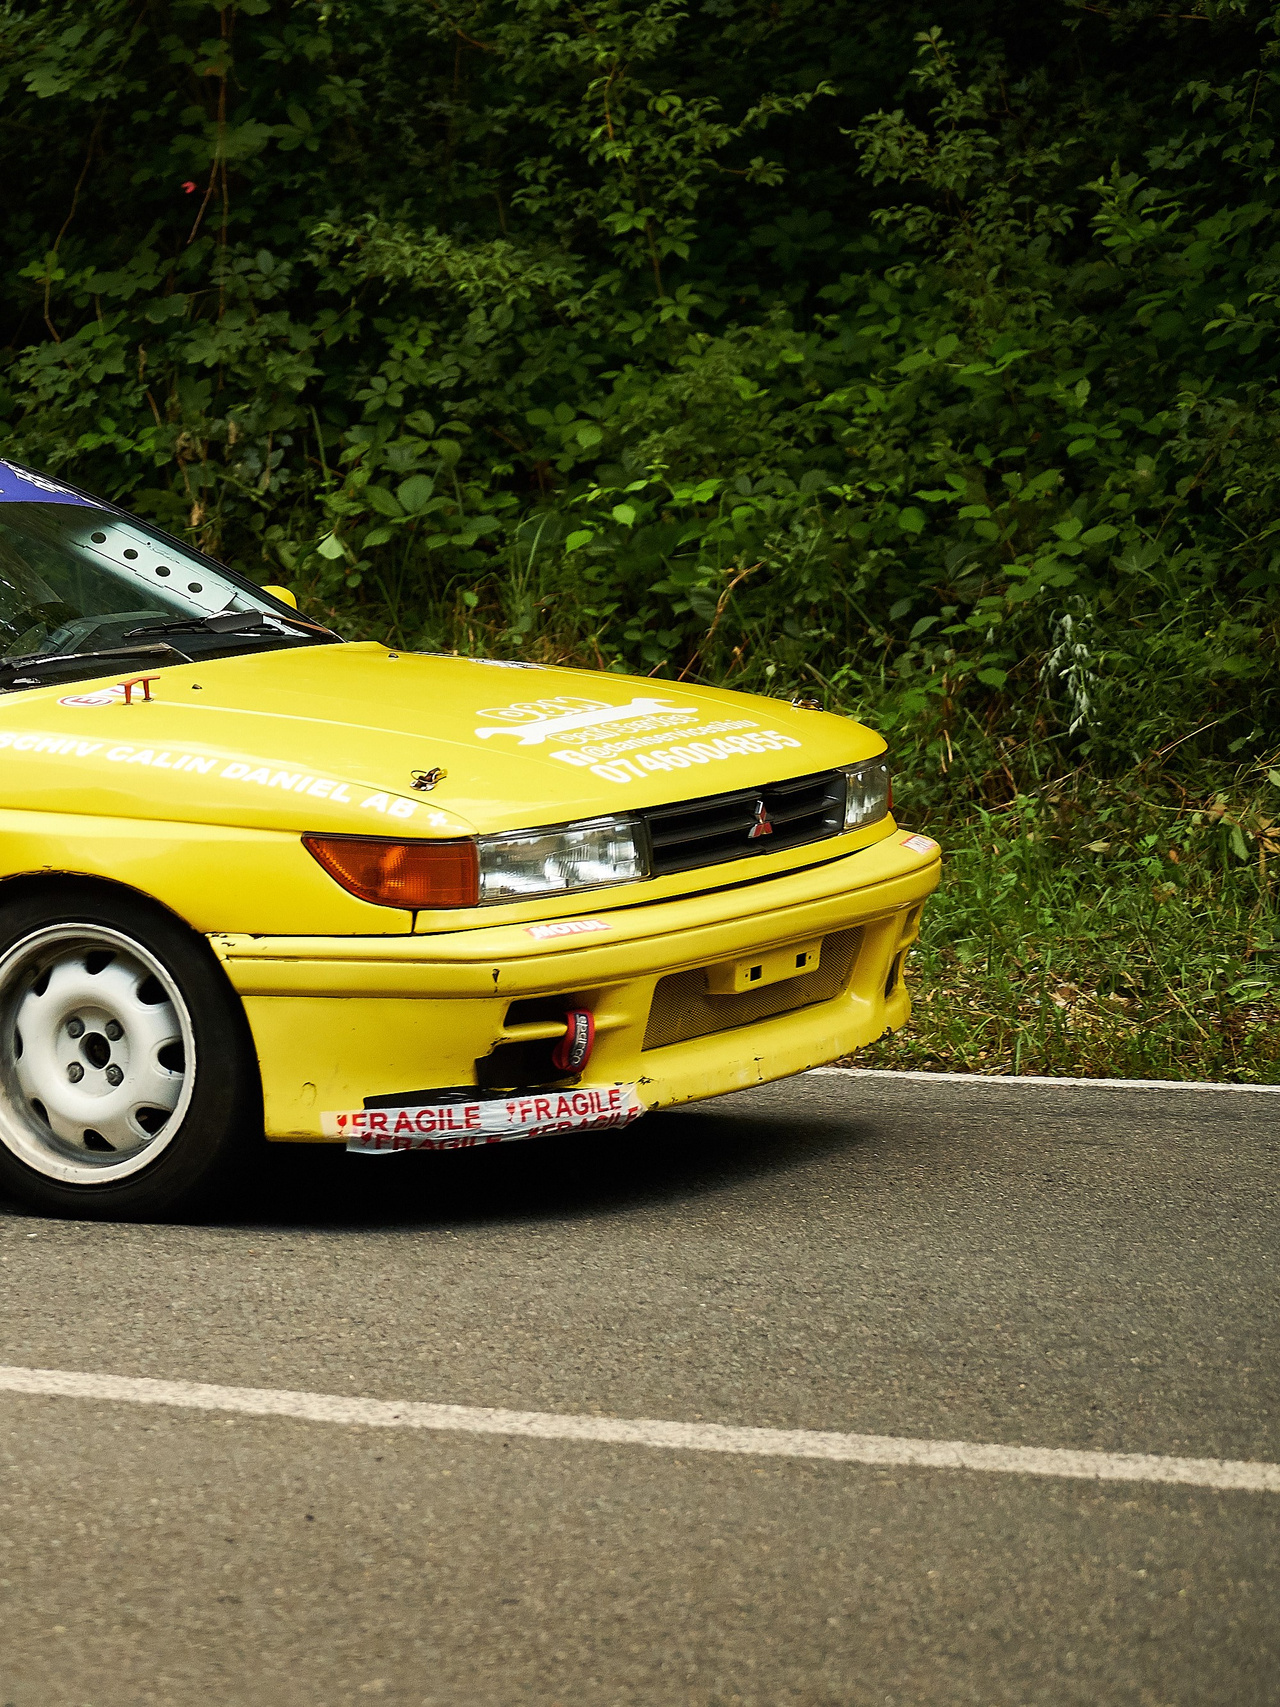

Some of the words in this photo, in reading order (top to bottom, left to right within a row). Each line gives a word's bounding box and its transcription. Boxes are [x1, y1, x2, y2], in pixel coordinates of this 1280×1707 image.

[106, 744, 223, 775] CALIN
[219, 761, 352, 803] DANIEL
[362, 793, 419, 819] AB
[590, 730, 802, 784] 0746004855
[529, 919, 609, 939] MOTUL
[570, 1013, 589, 1065] sparco
[351, 1105, 482, 1135] FRAGILE
[520, 1088, 622, 1123] FRAGILE
